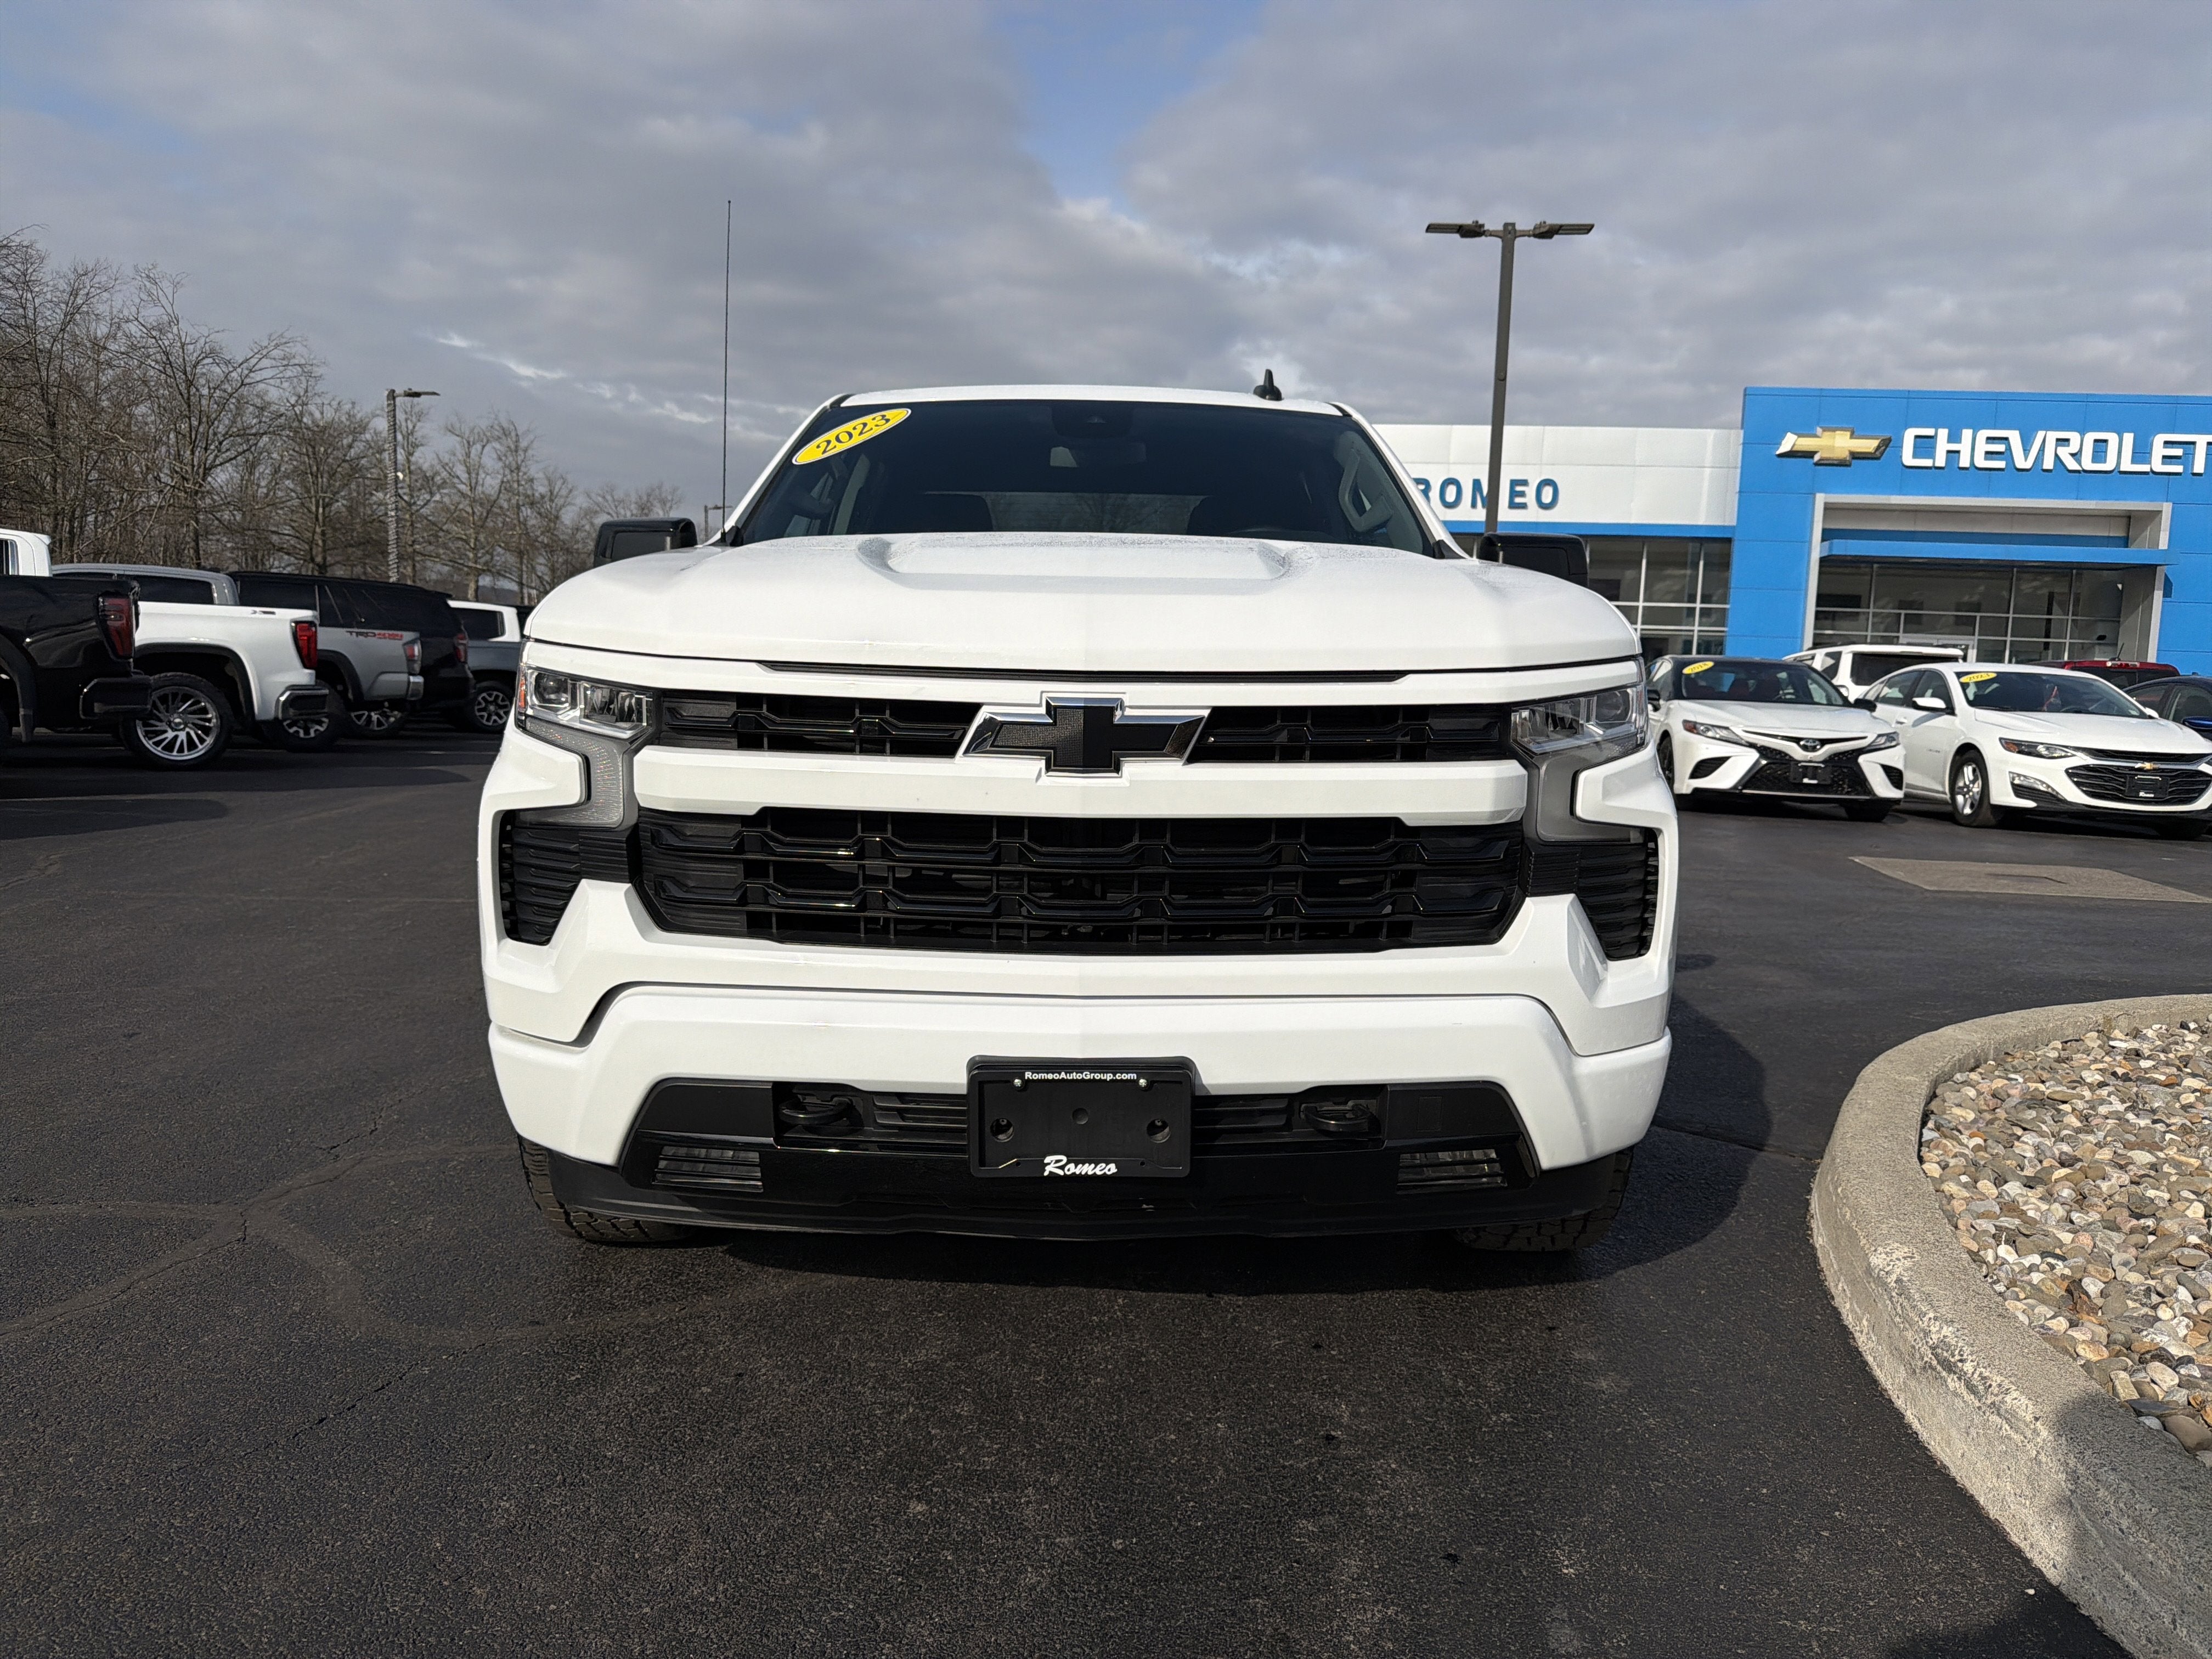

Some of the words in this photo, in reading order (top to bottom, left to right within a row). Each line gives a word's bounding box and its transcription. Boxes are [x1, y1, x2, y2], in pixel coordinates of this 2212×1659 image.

[816, 414, 891, 455] 2023
[1901, 427, 2212, 476] CHEVROLET
[1024, 1071, 1137, 1081] RomeoAutoGroup.com
[1043, 1155, 1118, 1176] Romeo
